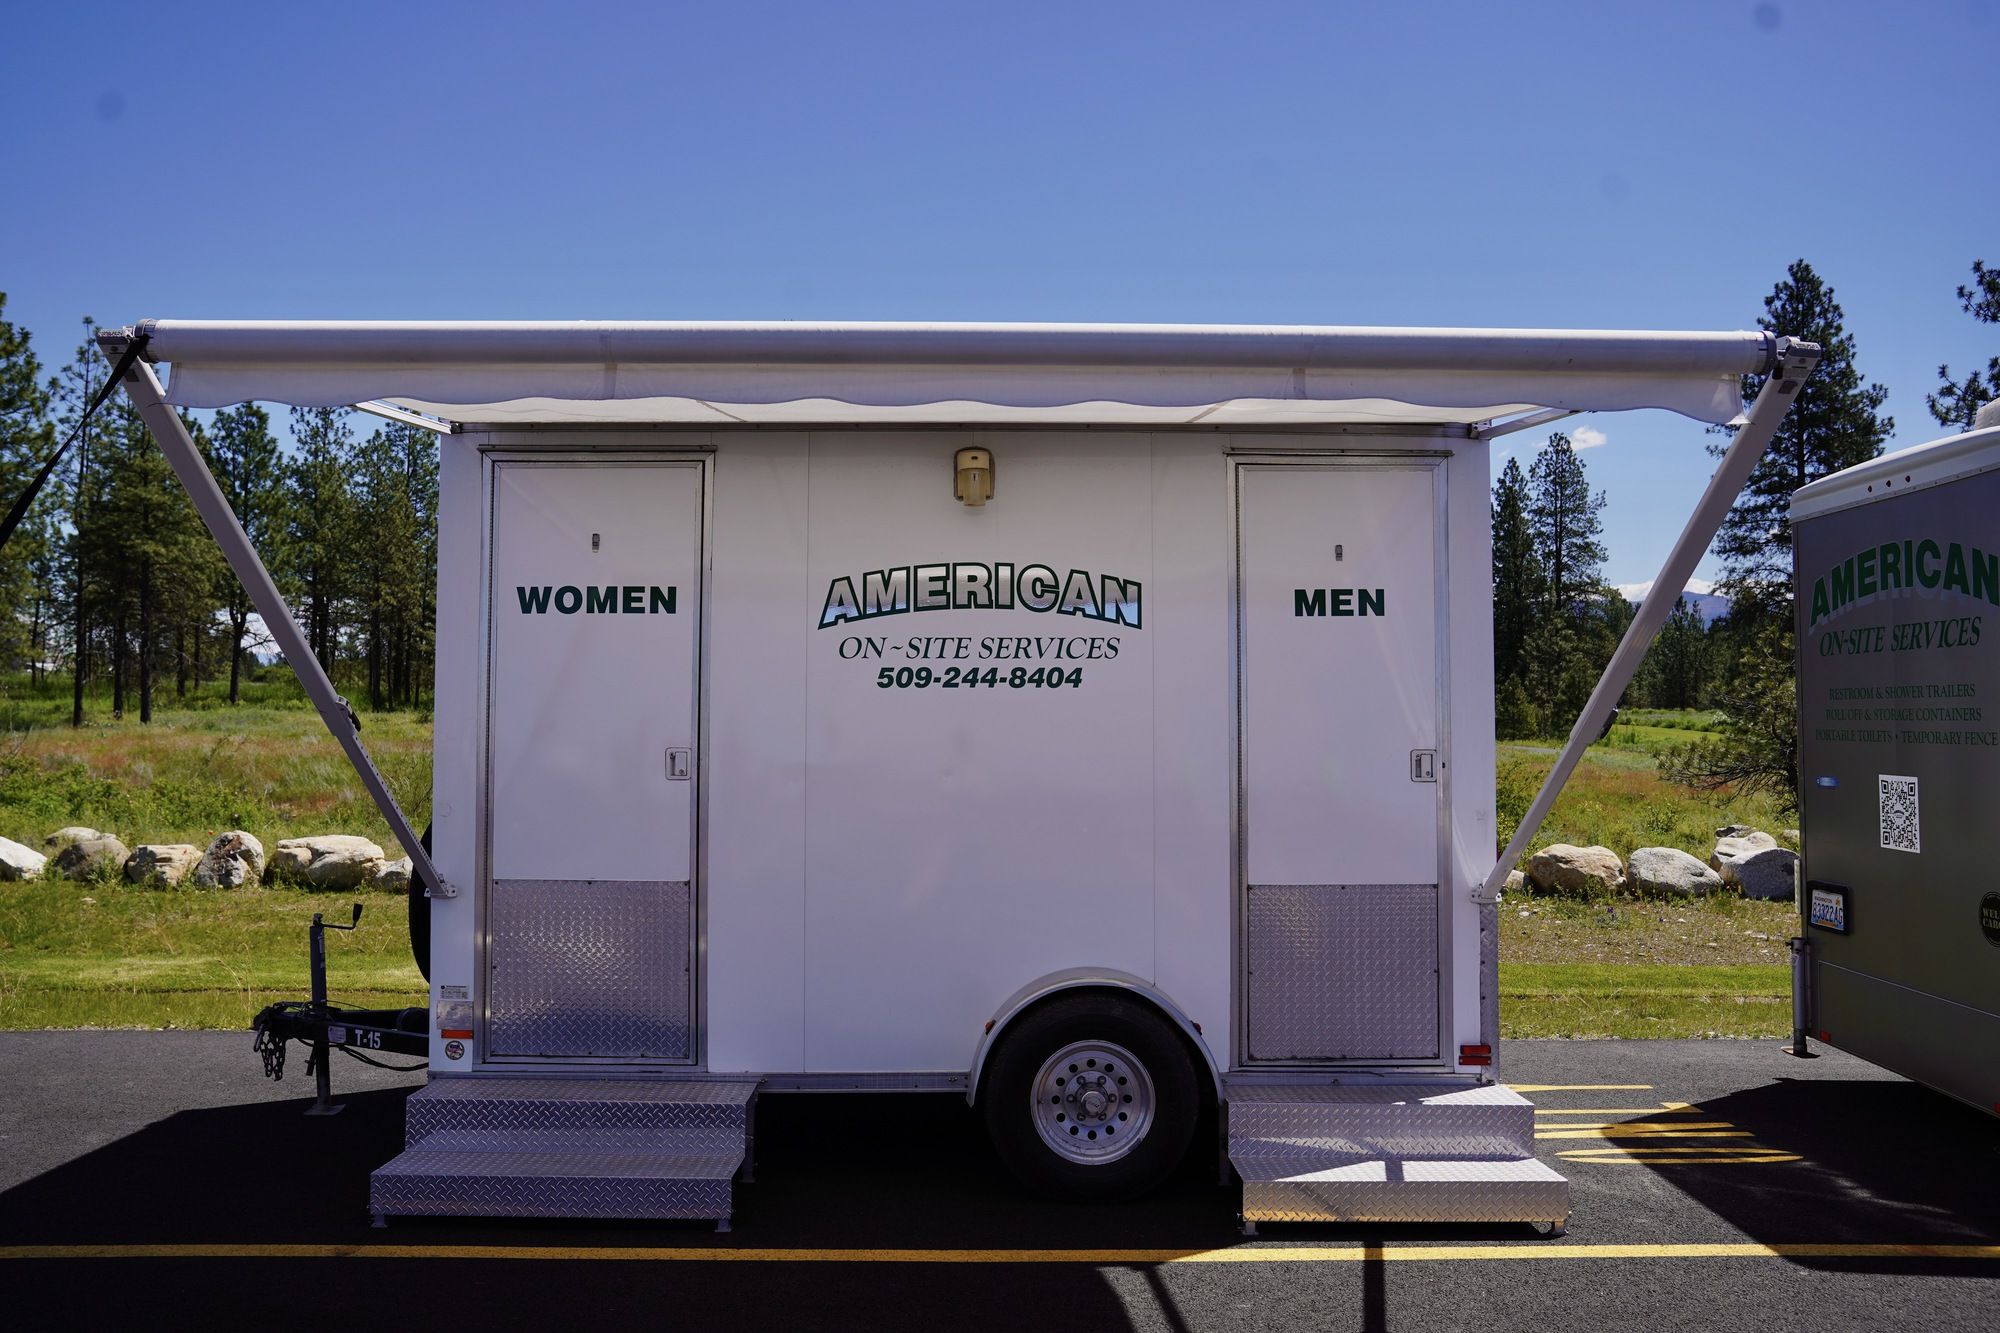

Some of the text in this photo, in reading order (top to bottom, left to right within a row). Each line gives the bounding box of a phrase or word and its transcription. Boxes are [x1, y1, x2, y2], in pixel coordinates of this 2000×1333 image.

[1809, 538, 2000, 629] AMERICAN
[516, 585, 677, 615] WOMEN
[817, 562, 1142, 630] AMERICAN
[1294, 588, 1385, 617] MEN
[978, 636, 1121, 660] SERVICES
[1819, 616, 1982, 657] ON-SITE SERVICES
[876, 666, 1083, 689] 509-244-8404
[1829, 683, 1976, 700] RESTROOM & SHOWER TRAILERS
[1864, 709, 1872, 721] &
[1873, 708, 1915, 721] STORAGE
[1916, 707, 1982, 721] CONTAINERS
[1815, 728, 1999, 746] PORTABLE TOILETS TEMPORARY FENCE
[354, 1029, 381, 1049] T-15
